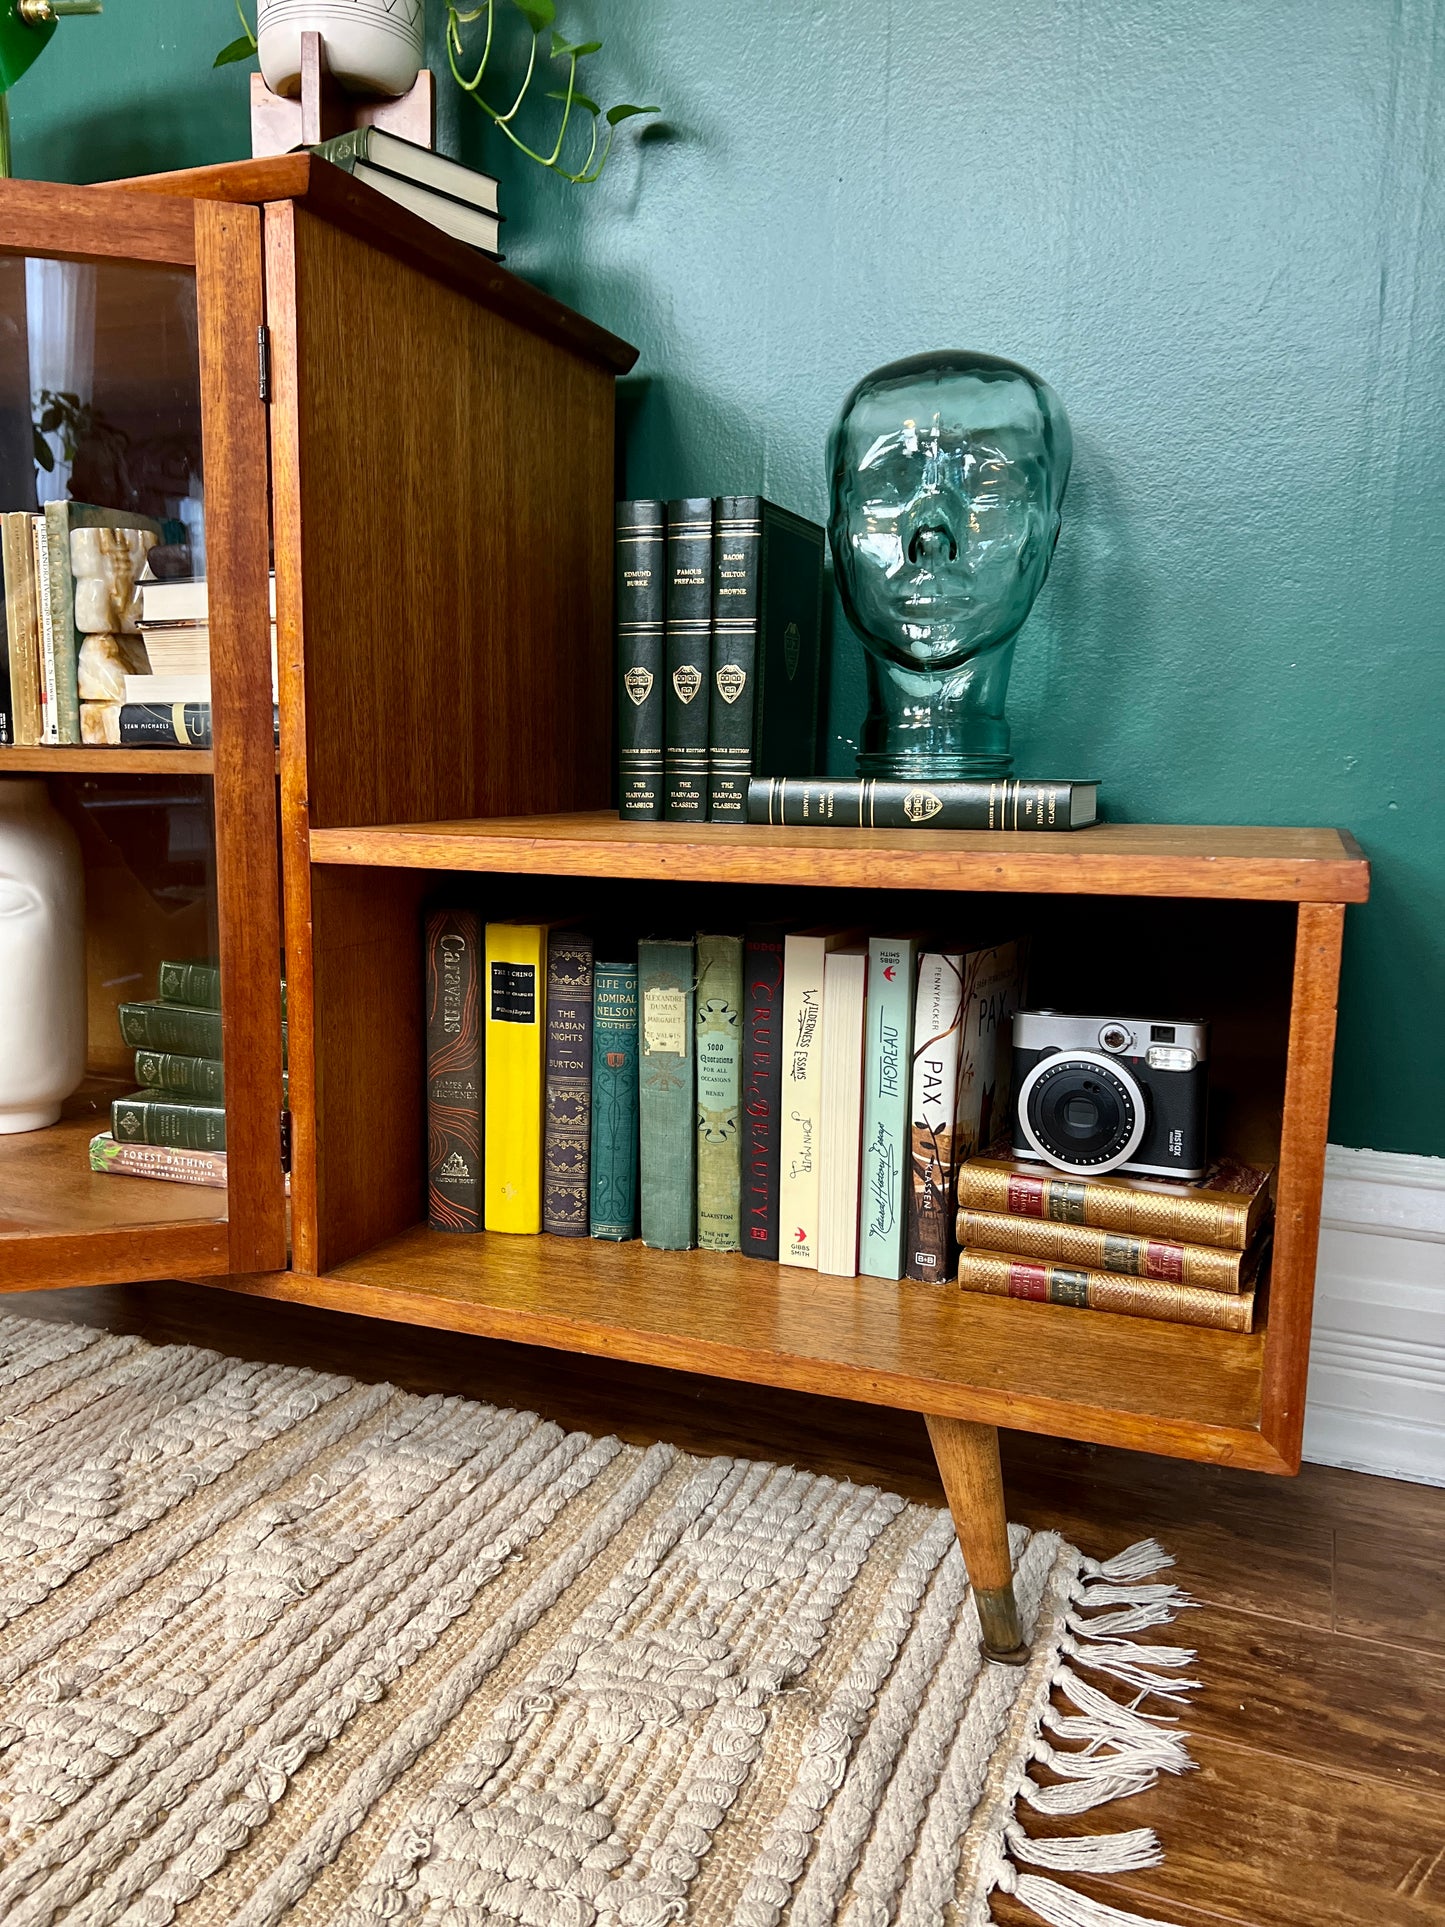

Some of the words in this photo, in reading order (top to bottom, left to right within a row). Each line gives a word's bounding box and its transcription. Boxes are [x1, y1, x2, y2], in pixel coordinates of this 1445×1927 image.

[40, 523, 50, 585] PERELANDRA
[722, 553, 745, 561] BACON
[623, 570, 652, 579] EDMUND
[676, 568, 703, 577] FAMOUS
[720, 570, 747, 579] MILTON
[626, 579, 649, 587] BURKE
[673, 577, 705, 586] PREFACES
[719, 588, 747, 596] BROWNE
[44, 616, 52, 626] to
[44, 626, 54, 653] Venus)
[632, 781, 646, 789] THE
[670, 791, 700, 799] HARVARD
[712, 792, 743, 800] HARVARD
[625, 801, 654, 809] CLASSICS
[670, 801, 699, 809] CLASSICS
[712, 802, 741, 810] CLASSICS
[818, 793, 826, 814] IZAAK
[827, 790, 835, 818] WALTON
[1025, 799, 1033, 815] THE
[1037, 788, 1045, 825] HARVARD
[1048, 790, 1056, 825] CLASSICS
[440, 934, 466, 1033] Caravans
[596, 979, 619, 989] LIFE
[625, 980, 638, 989] OF
[597, 993, 637, 1003] ADMIRAL
[931, 967, 942, 1031] PENNYPACKER
[597, 1006, 637, 1017] NELSON
[650, 1003, 678, 1011] DUMAS
[557, 1009, 576, 1019] THE
[800, 989, 819, 1048] WILDERNESS
[978, 990, 1008, 1037] PAX
[548, 1021, 586, 1031] ARABIAN
[596, 1021, 637, 1030] SOUTHEY
[752, 965, 779, 1084] CRUEL
[550, 1032, 584, 1042] NIGHTS
[707, 1042, 724, 1052] 5000
[548, 1059, 584, 1069] BURTON
[879, 1022, 899, 1099] THOREAU
[794, 1051, 809, 1081] ESSAYS
[700, 1075, 731, 1083] OCCASIONS
[922, 1060, 944, 1105] PAX
[434, 1080, 463, 1090] JAMES
[465, 1082, 476, 1090] A.
[1080, 1063, 1107, 1076] LENS
[1115, 1117, 1133, 1150] FOCUS
[791, 1111, 812, 1145] JOHN
[1168, 1144, 1174, 1152] 90
[1174, 1129, 1184, 1157] instax
[123, 1149, 162, 1163] FOREST
[166, 1154, 213, 1170] BATHING
[747, 1095, 770, 1220] BEAUTY
[790, 1146, 812, 1179] MUIR
[870, 1158, 891, 1204] History
[923, 1163, 934, 1210] KLASSEN
[700, 1211, 733, 1220] BLAKISTON
[714, 1236, 736, 1247] Library
[790, 1243, 810, 1251] GIBBS
[790, 1250, 810, 1258] SMITH
[917, 1255, 934, 1264] B+B
